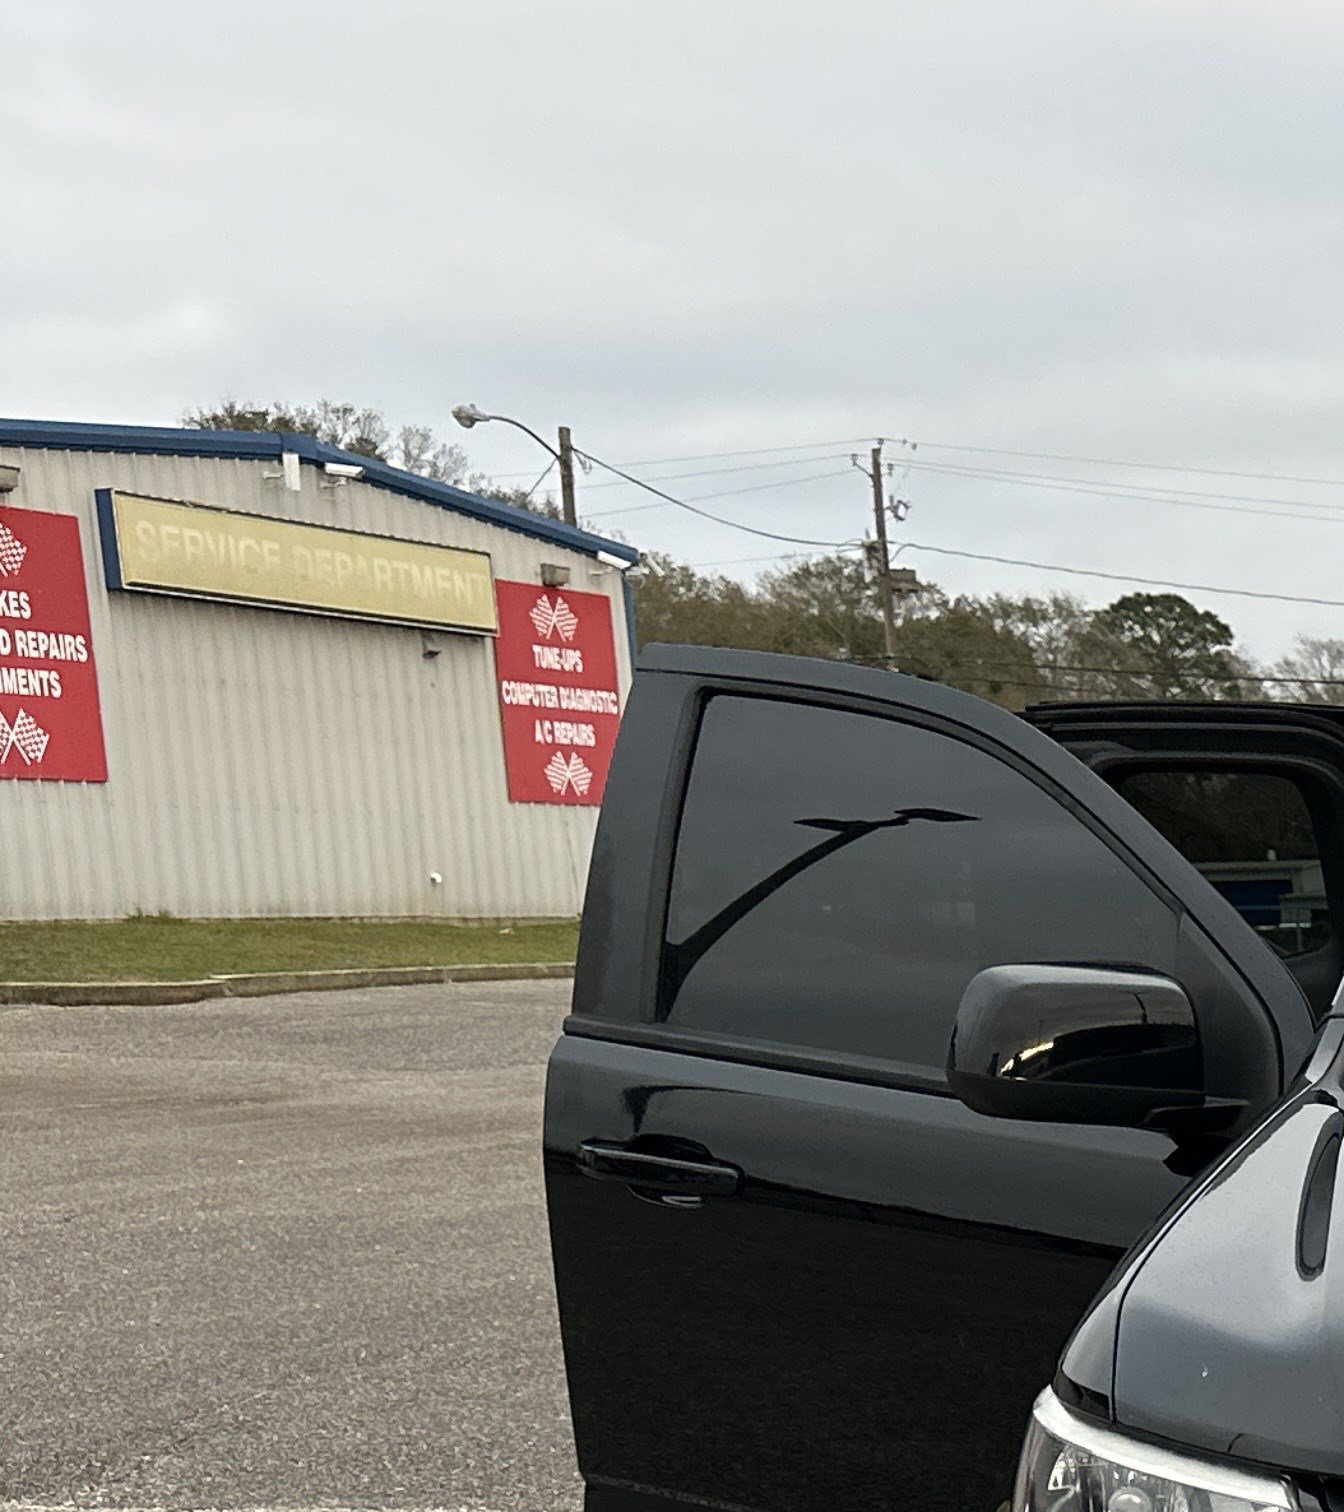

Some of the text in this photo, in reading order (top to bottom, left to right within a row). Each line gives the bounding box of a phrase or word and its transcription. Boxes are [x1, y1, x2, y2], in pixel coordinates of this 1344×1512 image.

[134, 519, 489, 608] SERVICE DEPARTMENT
[14, 629, 89, 663] REPAIRS
[532, 644, 584, 673] TUNE-UPS
[0, 667, 62, 699] MENTS
[501, 680, 619, 715] COMPUTER DIAGNOSTIC
[553, 721, 597, 747] REPAIRS
